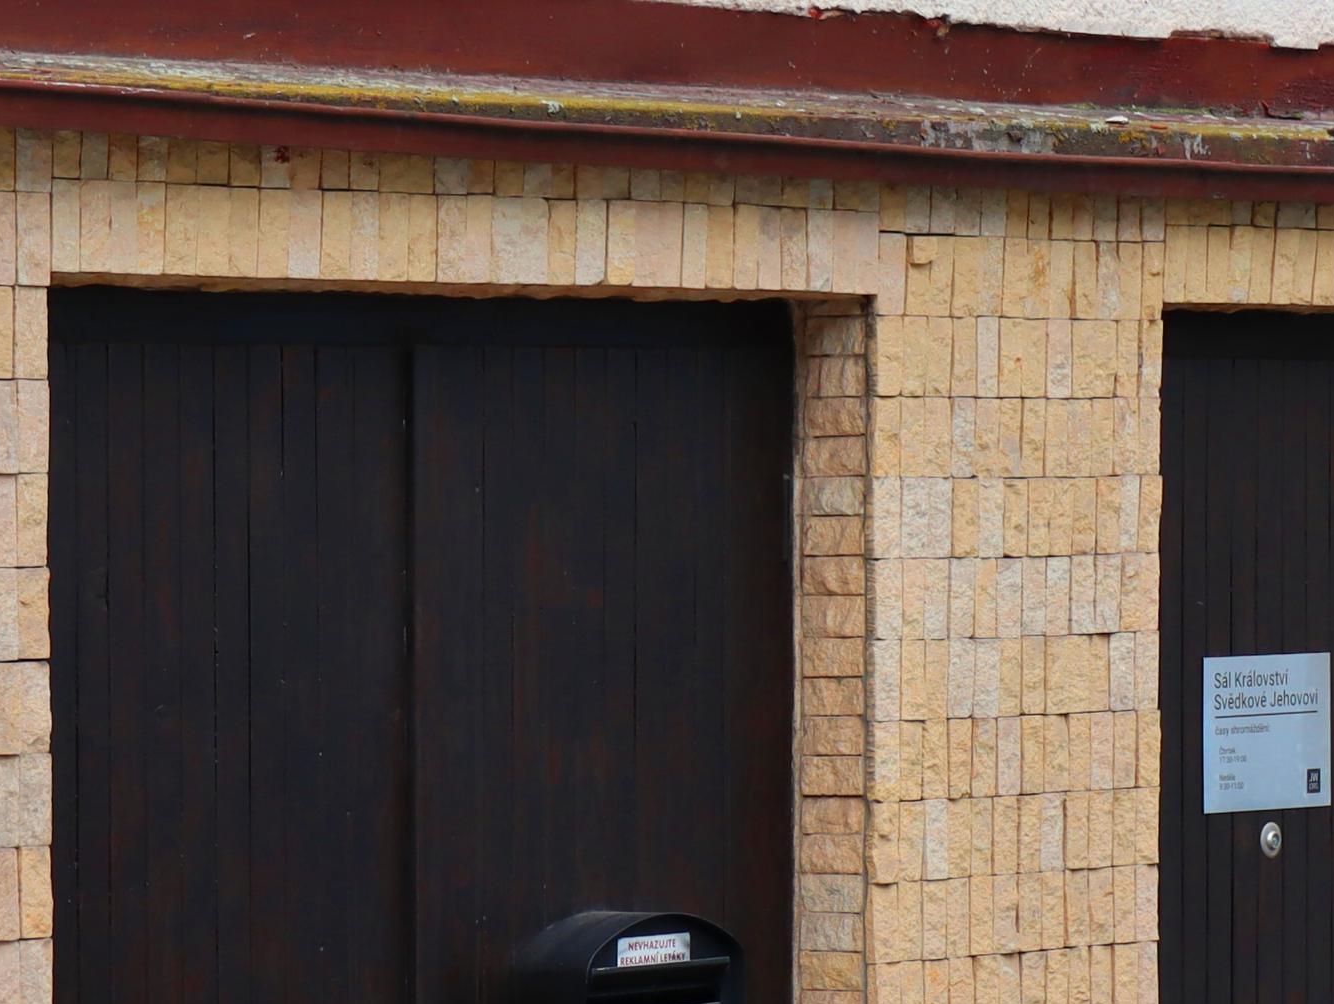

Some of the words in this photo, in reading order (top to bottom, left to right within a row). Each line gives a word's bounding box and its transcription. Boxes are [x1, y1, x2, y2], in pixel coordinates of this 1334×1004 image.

[1214, 672, 1231, 689] Sál
[1234, 668, 1289, 688] Království
[1214, 690, 1267, 710] Svědkové
[1270, 687, 1319, 708] Jehovovi
[628, 938, 676, 951] NEVHAZUJTE
[620, 951, 659, 966] REKLAMNÍ
[660, 950, 686, 962] LETÁKY
